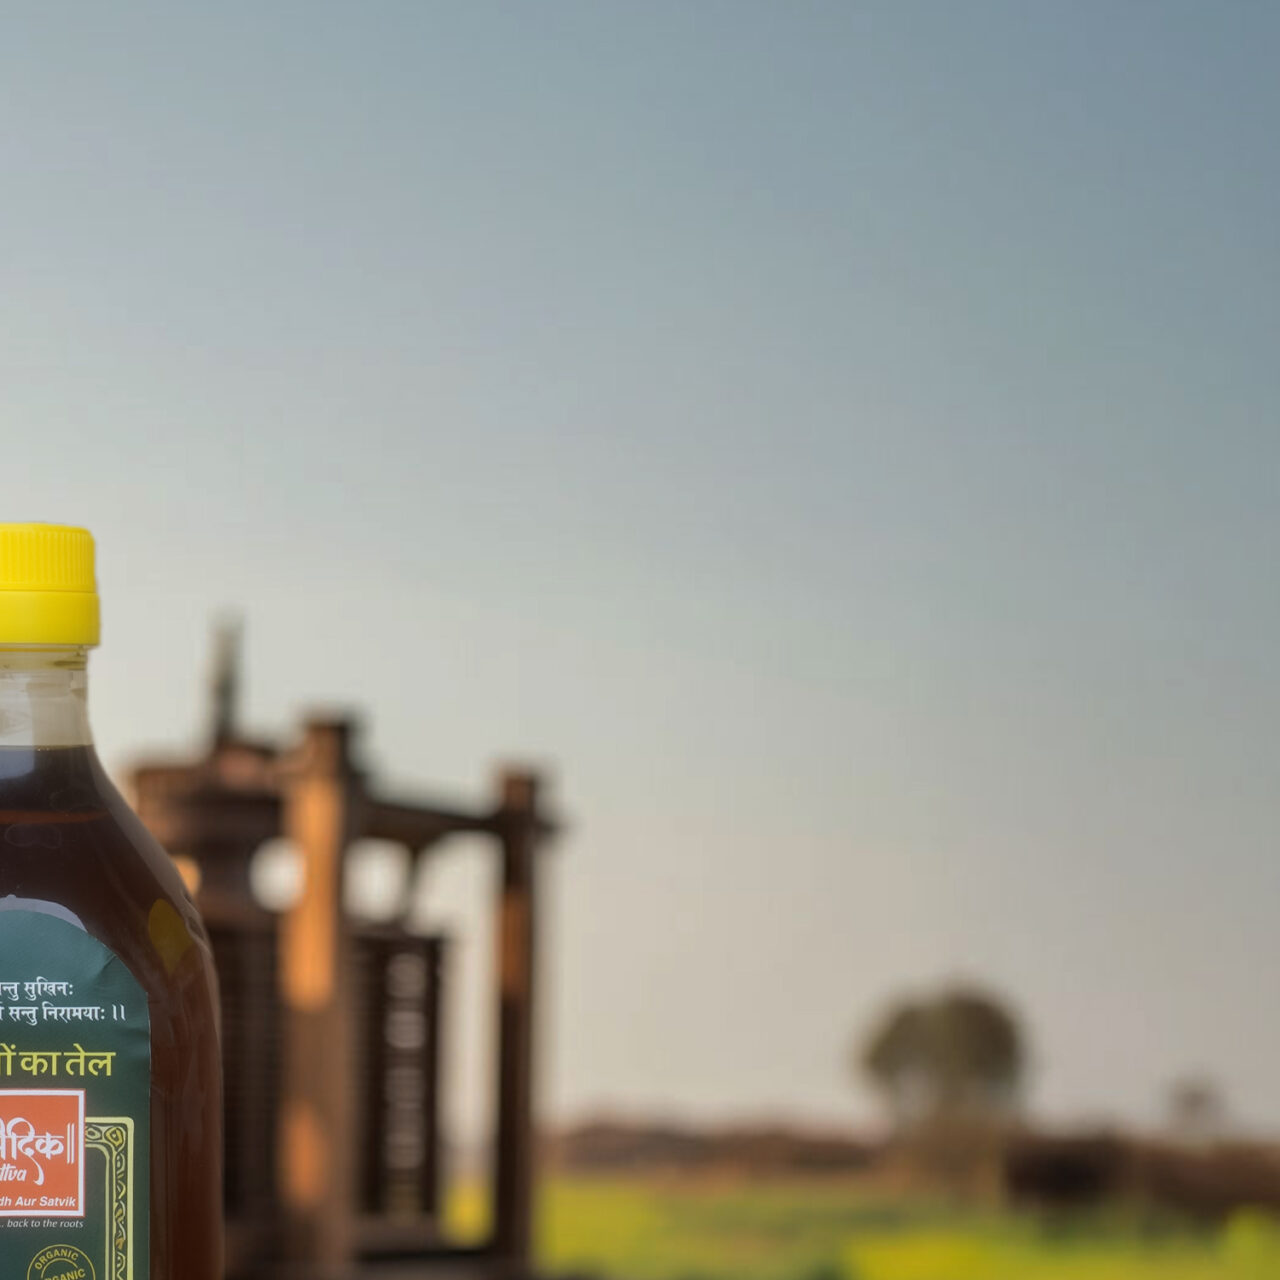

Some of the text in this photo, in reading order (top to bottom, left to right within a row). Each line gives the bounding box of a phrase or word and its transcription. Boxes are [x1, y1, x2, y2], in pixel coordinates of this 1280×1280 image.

[8, 1006, 39, 1026] सन्तु
[18, 1052, 62, 1076] का
[63, 1043, 116, 1076] तेल
[15, 1196, 36, 1207] Aur
[39, 1196, 76, 1207] Satvik
[7, 1218, 29, 1228] back
[30, 1219, 41, 1228] to
[42, 1219, 58, 1228] the
[59, 1219, 84, 1228] roots
[34, 1248, 79, 1270] ORGANIC
